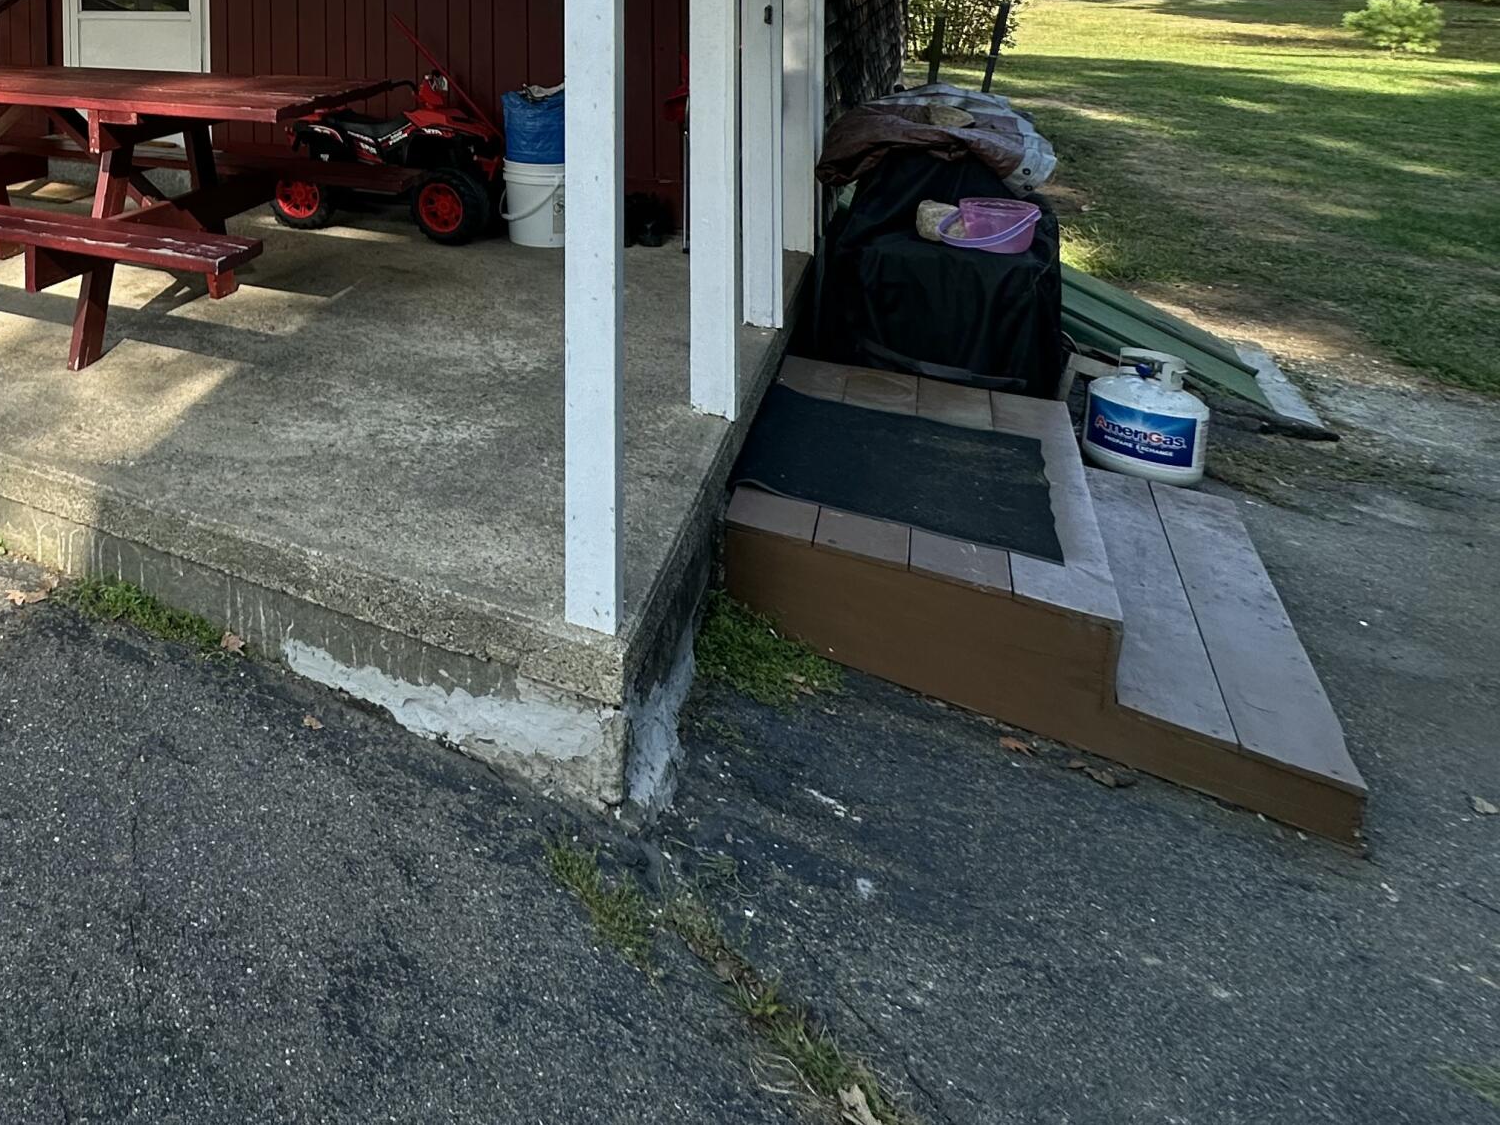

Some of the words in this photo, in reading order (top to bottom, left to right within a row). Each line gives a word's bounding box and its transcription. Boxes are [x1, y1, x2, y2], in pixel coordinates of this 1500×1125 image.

[1094, 414, 1186, 449] AmeriGas
[1104, 435, 1134, 448] PROPANE
[1136, 443, 1174, 457] EXCHANGE
